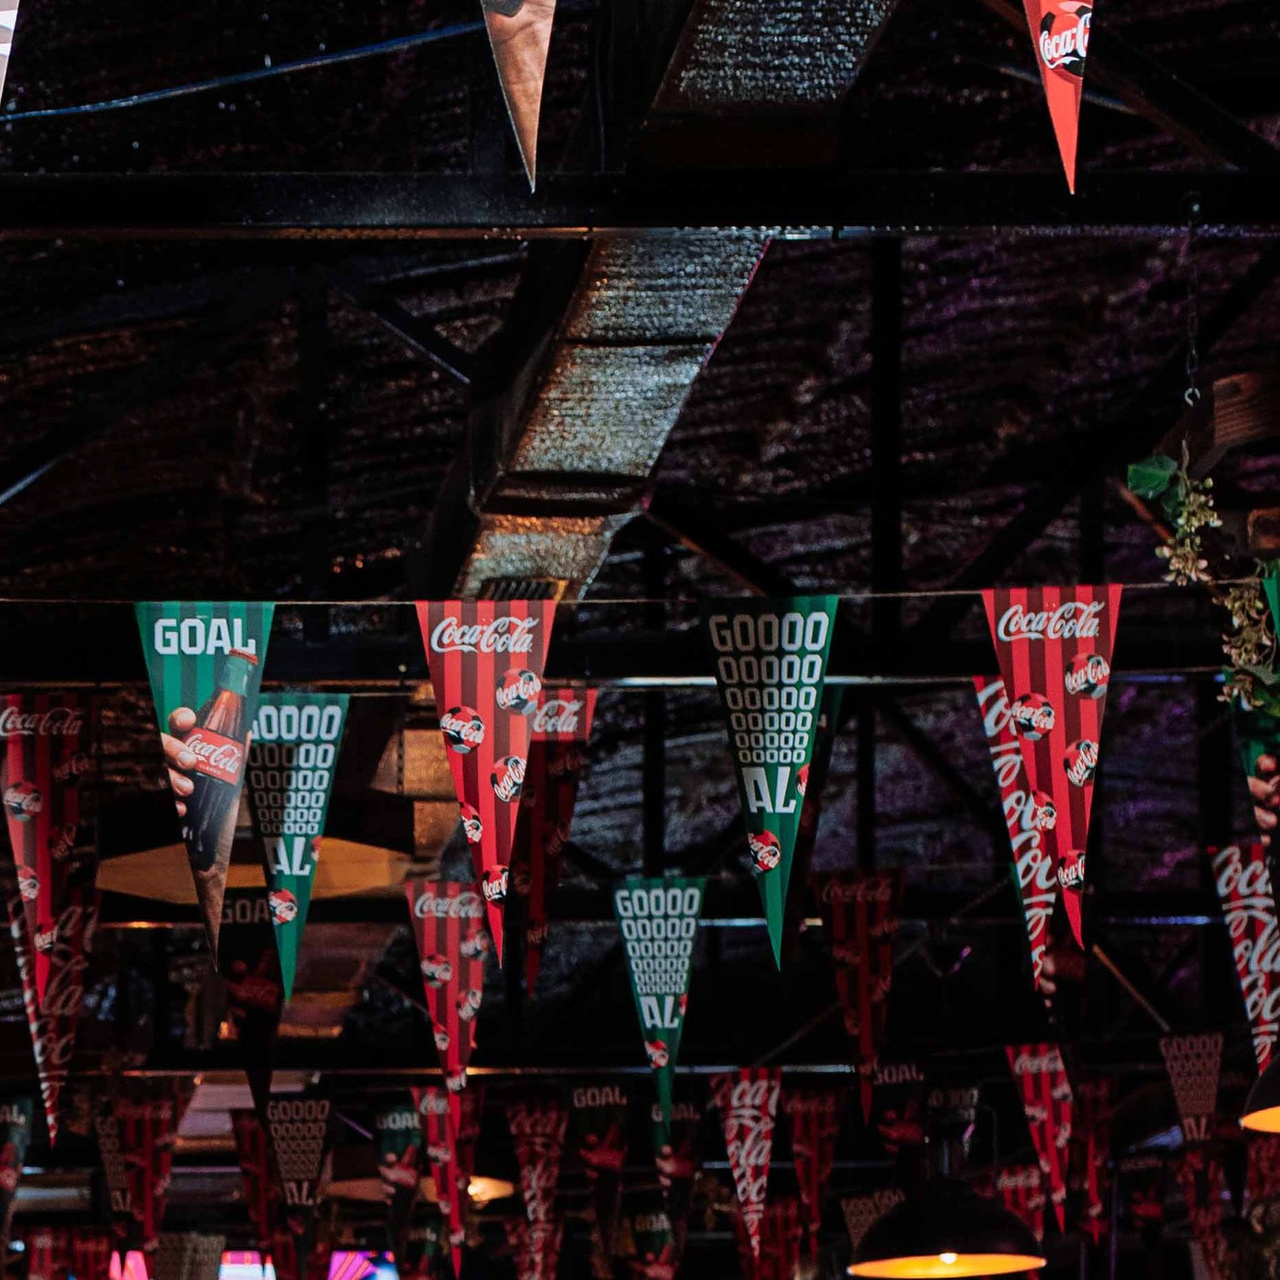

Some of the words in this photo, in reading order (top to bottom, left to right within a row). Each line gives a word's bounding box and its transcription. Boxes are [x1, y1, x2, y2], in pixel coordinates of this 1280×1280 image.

[429, 615, 540, 655] Coca-Cola
[709, 611, 829, 651] GOOOO
[998, 600, 1104, 641] Coca-Cola
[154, 618, 256, 656] GOAL
[718, 655, 822, 684] OOOOO
[725, 686, 816, 710] OOOOO
[731, 712, 811, 732] OOOOO
[185, 733, 241, 775] Coca-Cola
[736, 732, 809, 749] OOOOO
[738, 749, 806, 763] OOOOO
[741, 766, 796, 814] AL
[262, 837, 311, 876] AL
[415, 890, 484, 919] Coca-Cola
[267, 1099, 331, 1121] GOOOO
[572, 1086, 628, 1108] GOAL
